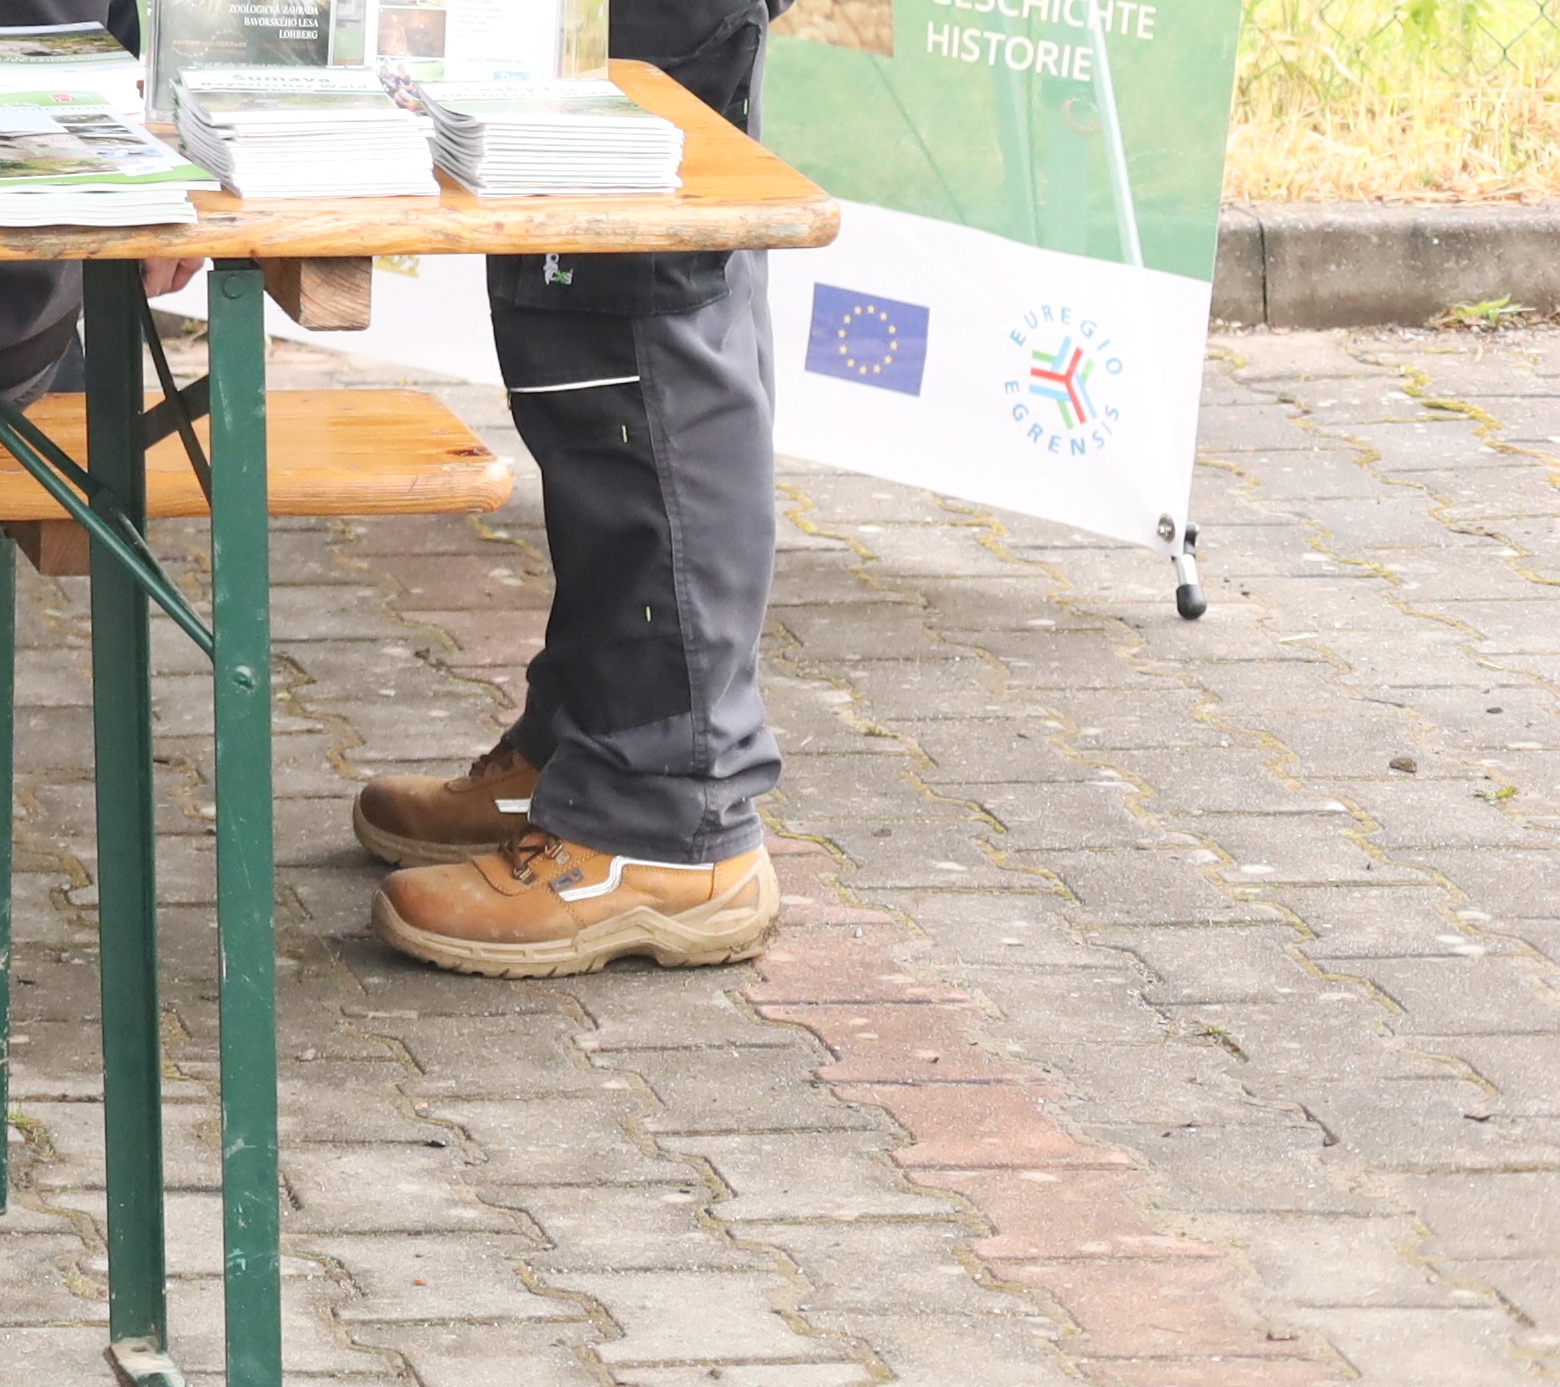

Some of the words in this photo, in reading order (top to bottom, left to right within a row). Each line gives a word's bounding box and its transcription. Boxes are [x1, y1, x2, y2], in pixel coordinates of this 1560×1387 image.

[279, 29, 318, 40] LOHBERG
[298, 18, 318, 27] LESA
[926, 22, 1094, 82] HISTORIE
[1009, 303, 1124, 377] EUREGIO
[1004, 379, 1120, 457] EGRENSIS
